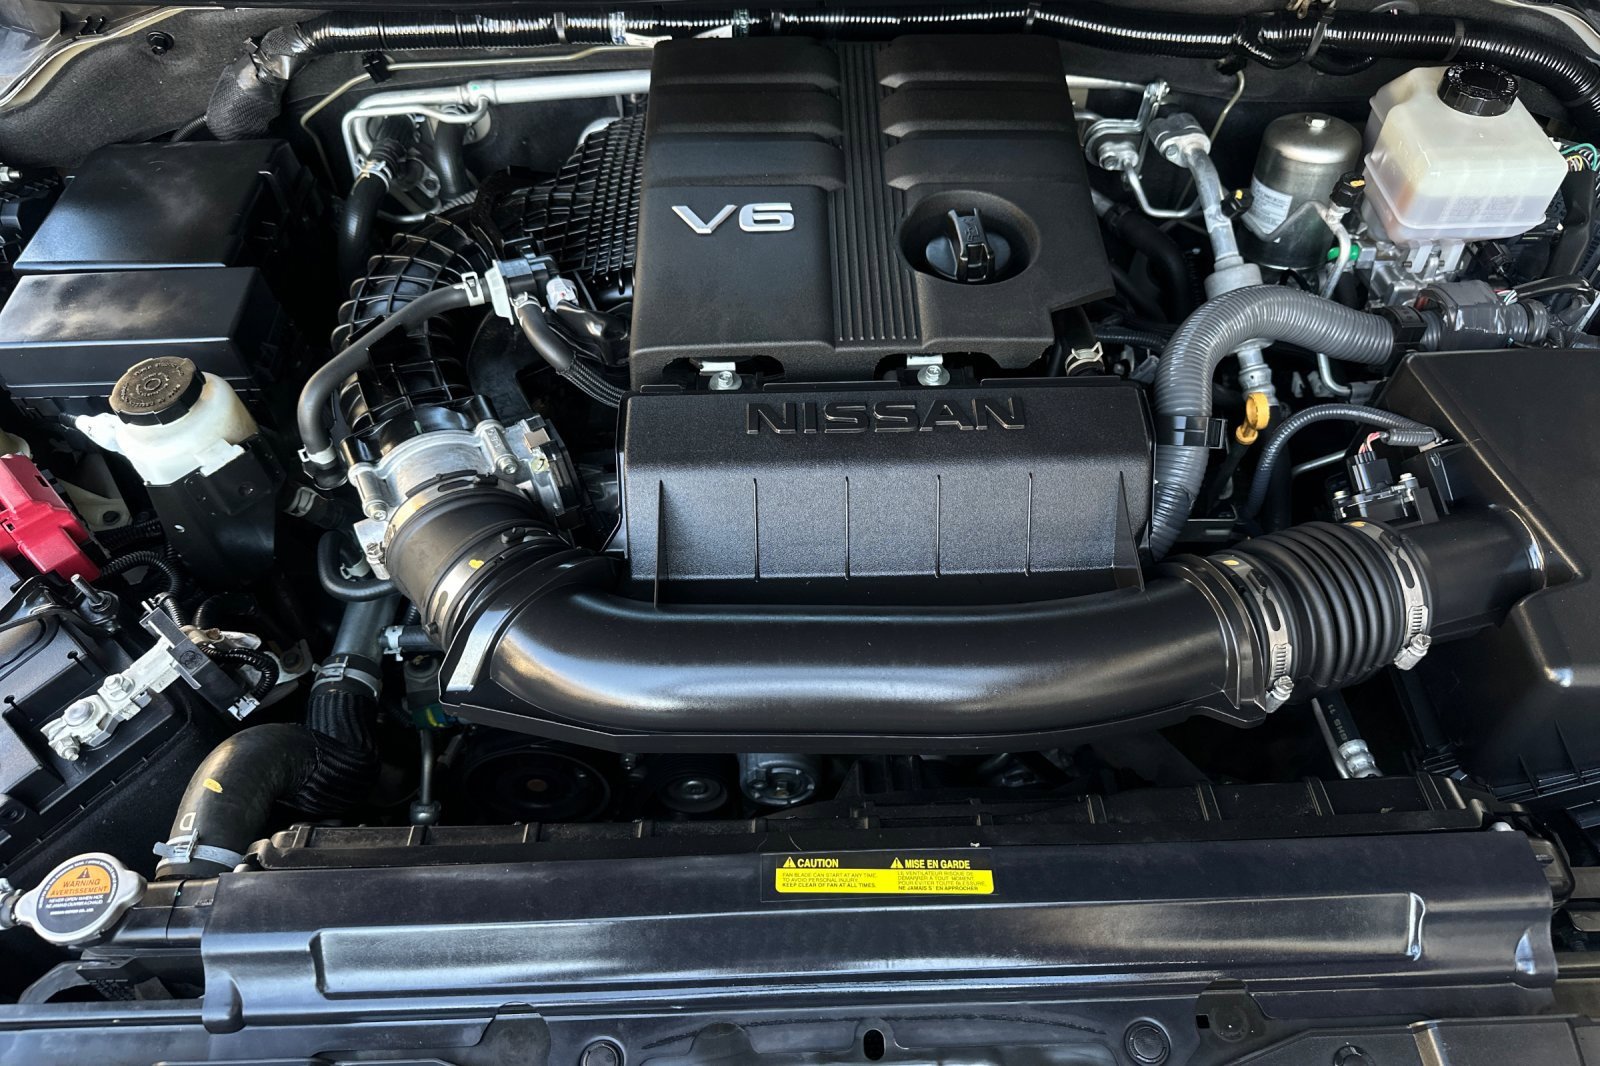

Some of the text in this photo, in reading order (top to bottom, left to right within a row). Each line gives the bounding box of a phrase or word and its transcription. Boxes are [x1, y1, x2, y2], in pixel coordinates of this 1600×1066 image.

[671, 202, 796, 234] V6
[745, 397, 1026, 434] NISSAN
[797, 858, 839, 868] CAUTION
[904, 859, 971, 869] MISE EN GARDE
[63, 878, 101, 888] WARNING
[50, 885, 109, 896] AVERTISSEMENT
